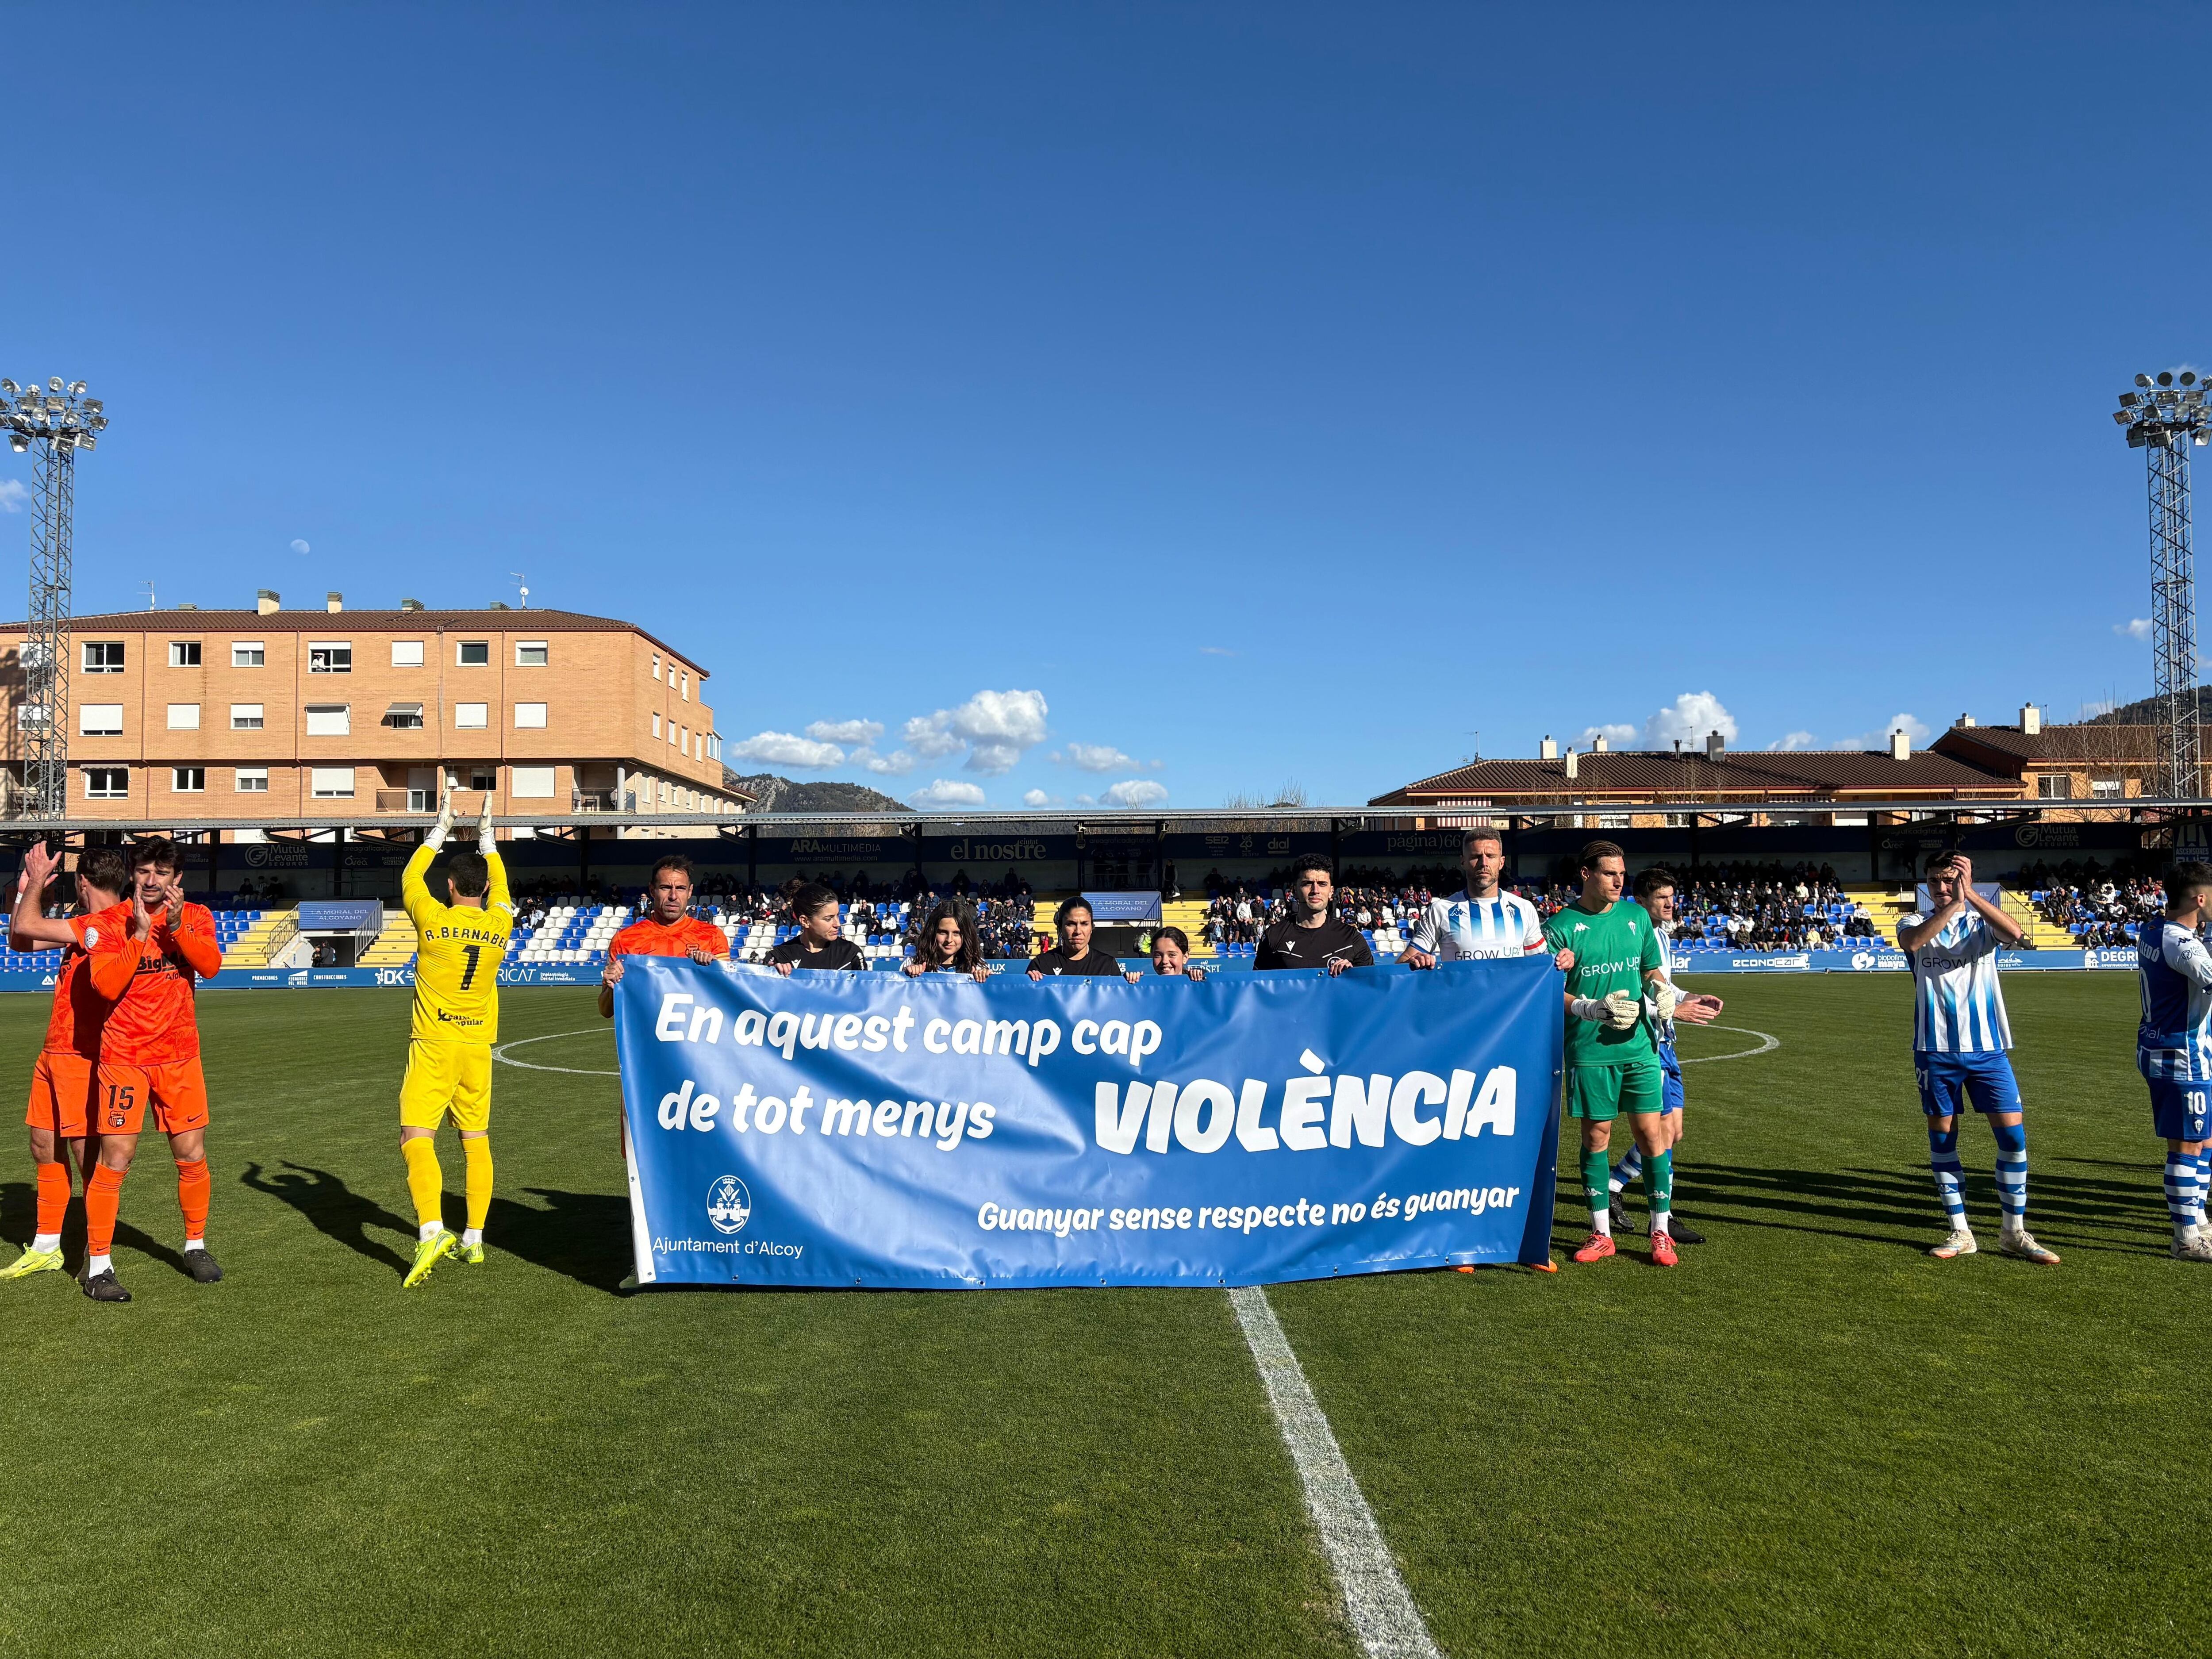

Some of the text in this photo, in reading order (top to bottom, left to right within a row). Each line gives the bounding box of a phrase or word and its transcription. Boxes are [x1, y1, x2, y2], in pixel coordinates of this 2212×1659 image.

[2041, 825, 2077, 834] Mutua
[270, 844, 306, 853] Mutua
[950, 838, 1046, 860] el nostre
[1267, 837, 1289, 849] dial
[1455, 949, 1499, 960] GROW
[1878, 961, 1905, 970] maya
[1922, 957, 1967, 969] GROW
[461, 945, 480, 991] 1
[1581, 961, 1624, 977] GROW
[656, 993, 1162, 1067] En aquest camp cap
[108, 1084, 134, 1110] 15
[1095, 1048, 1517, 1155] VIOLÈNCIA
[2184, 1091, 2207, 1115] 10
[658, 1080, 997, 1152] de tot menys
[977, 1187, 1520, 1238] Guanyar sense respecte no és guanyar
[652, 1237, 803, 1260] Ajuntament d’Alcoy
